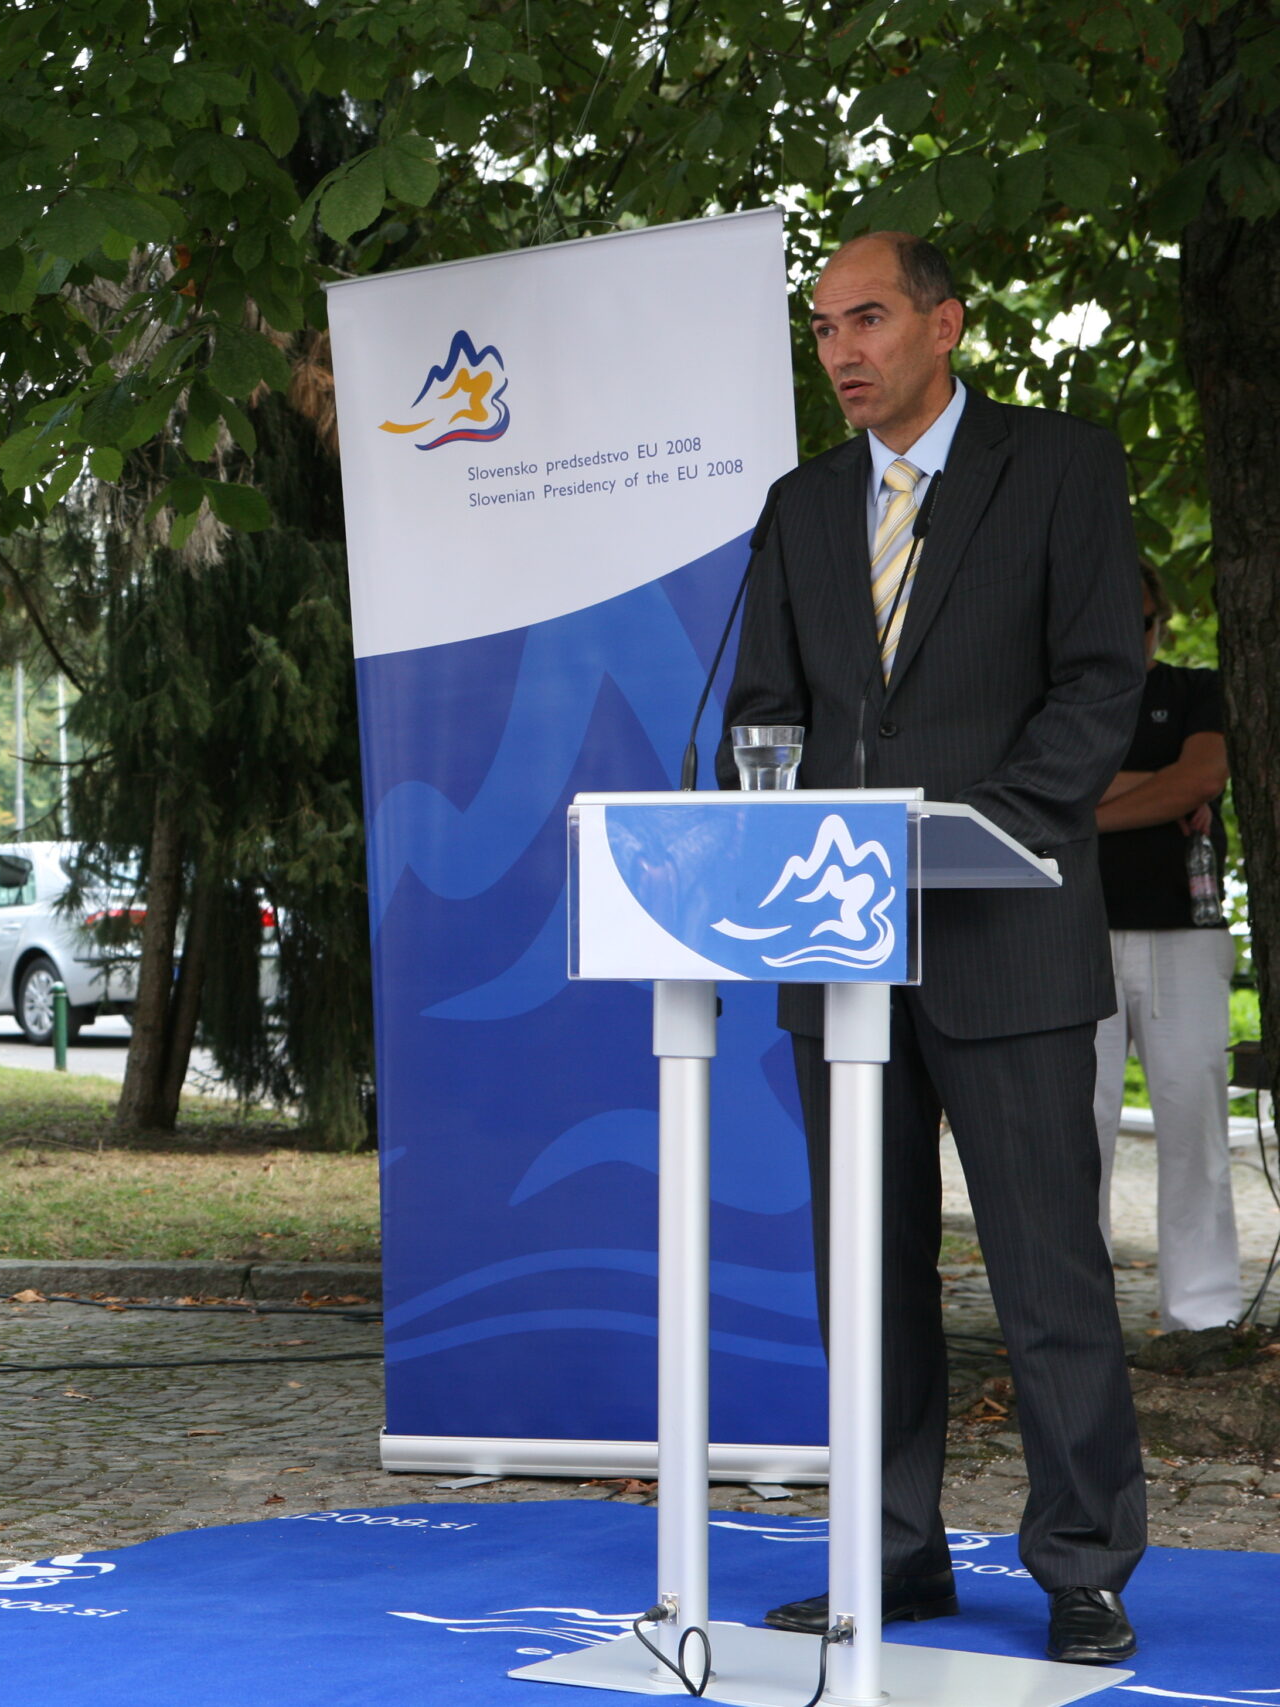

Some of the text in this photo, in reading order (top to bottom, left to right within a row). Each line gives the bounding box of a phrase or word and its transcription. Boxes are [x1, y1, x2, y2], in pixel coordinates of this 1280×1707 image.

[467, 437, 702, 481] Slovensko predsedstvo EU 2008
[469, 459, 744, 507] Slovenian Presidency of the EU 2008
[277, 1512, 478, 1531] u2008.si
